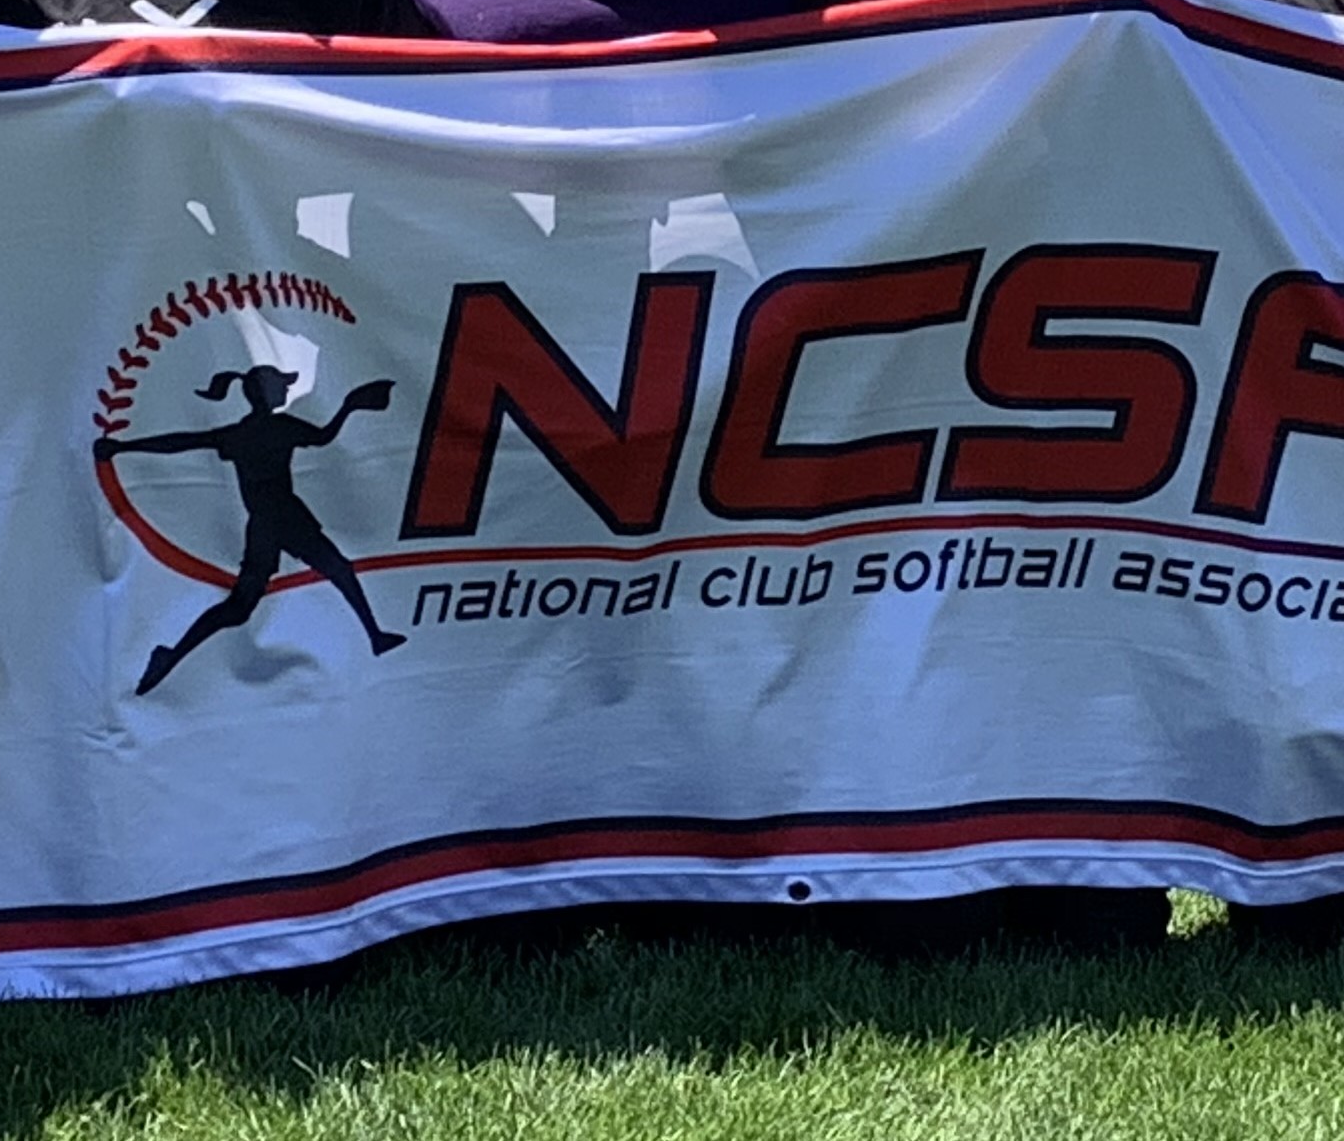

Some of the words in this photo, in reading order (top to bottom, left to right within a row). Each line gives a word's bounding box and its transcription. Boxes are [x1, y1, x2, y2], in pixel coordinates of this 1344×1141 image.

[412, 560, 681, 627] national
[700, 554, 833, 609] club
[852, 537, 1095, 596] softball
